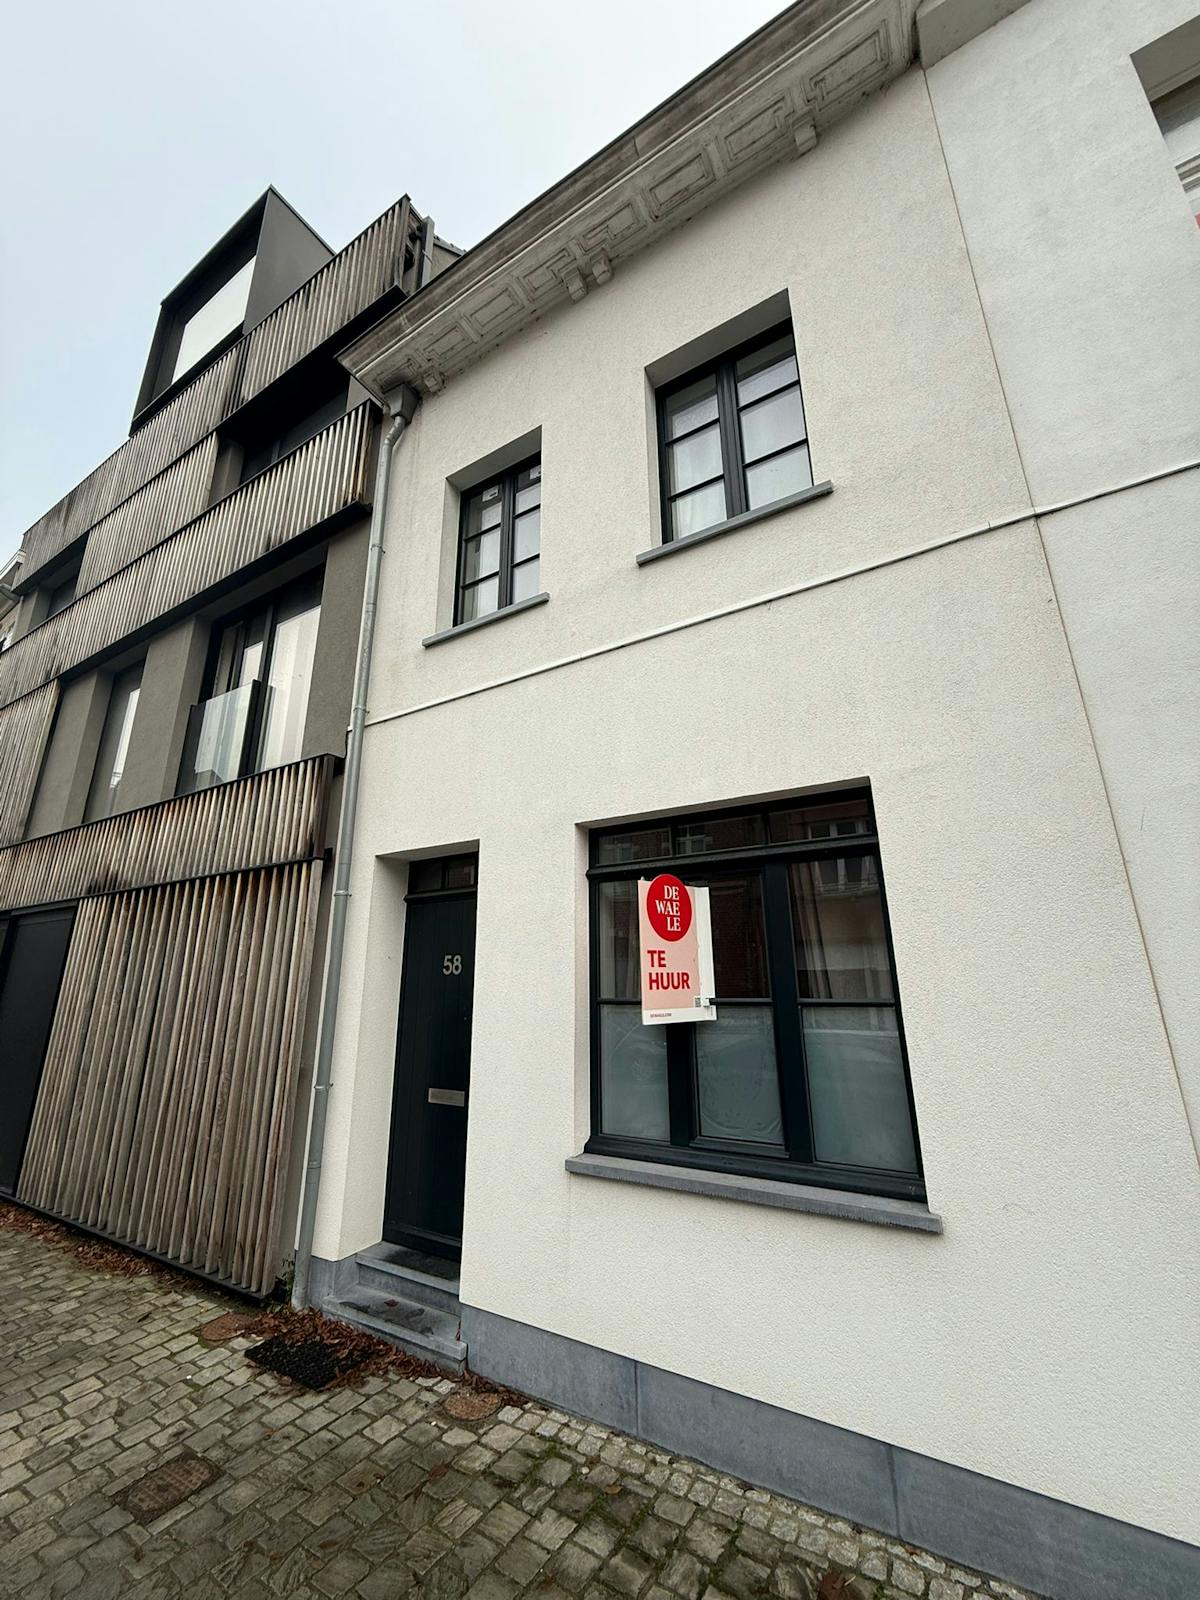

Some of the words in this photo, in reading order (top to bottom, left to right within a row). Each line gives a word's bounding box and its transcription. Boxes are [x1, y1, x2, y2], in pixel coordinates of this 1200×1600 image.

[664, 885, 680, 900] DE
[655, 899, 680, 916] WAE
[666, 917, 681, 931] LE
[443, 955, 462, 975] 58
[647, 950, 666, 967] TE
[649, 972, 690, 990] HUUR
